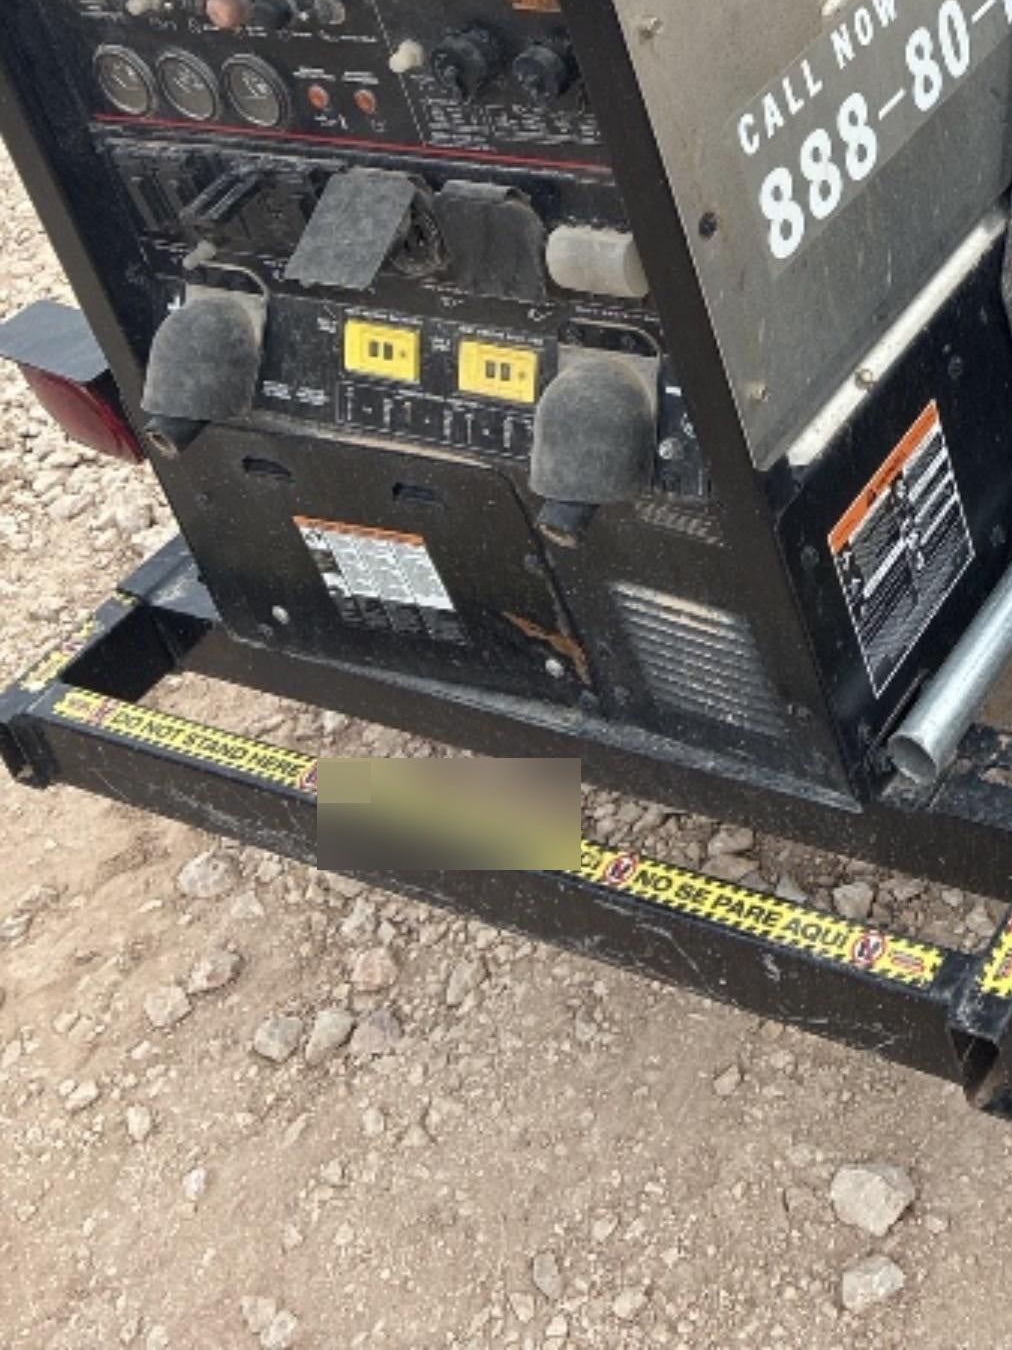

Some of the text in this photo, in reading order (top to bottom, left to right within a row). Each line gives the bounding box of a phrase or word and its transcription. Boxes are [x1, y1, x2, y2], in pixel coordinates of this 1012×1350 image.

[736, 58, 824, 156] CALL
[141, 720, 184, 742] NOT
[183, 731, 247, 760] STAND
[247, 752, 300, 777] HERE
[633, 870, 672, 892] NO
[674, 881, 710, 903] SE
[712, 895, 783, 928] PARE
